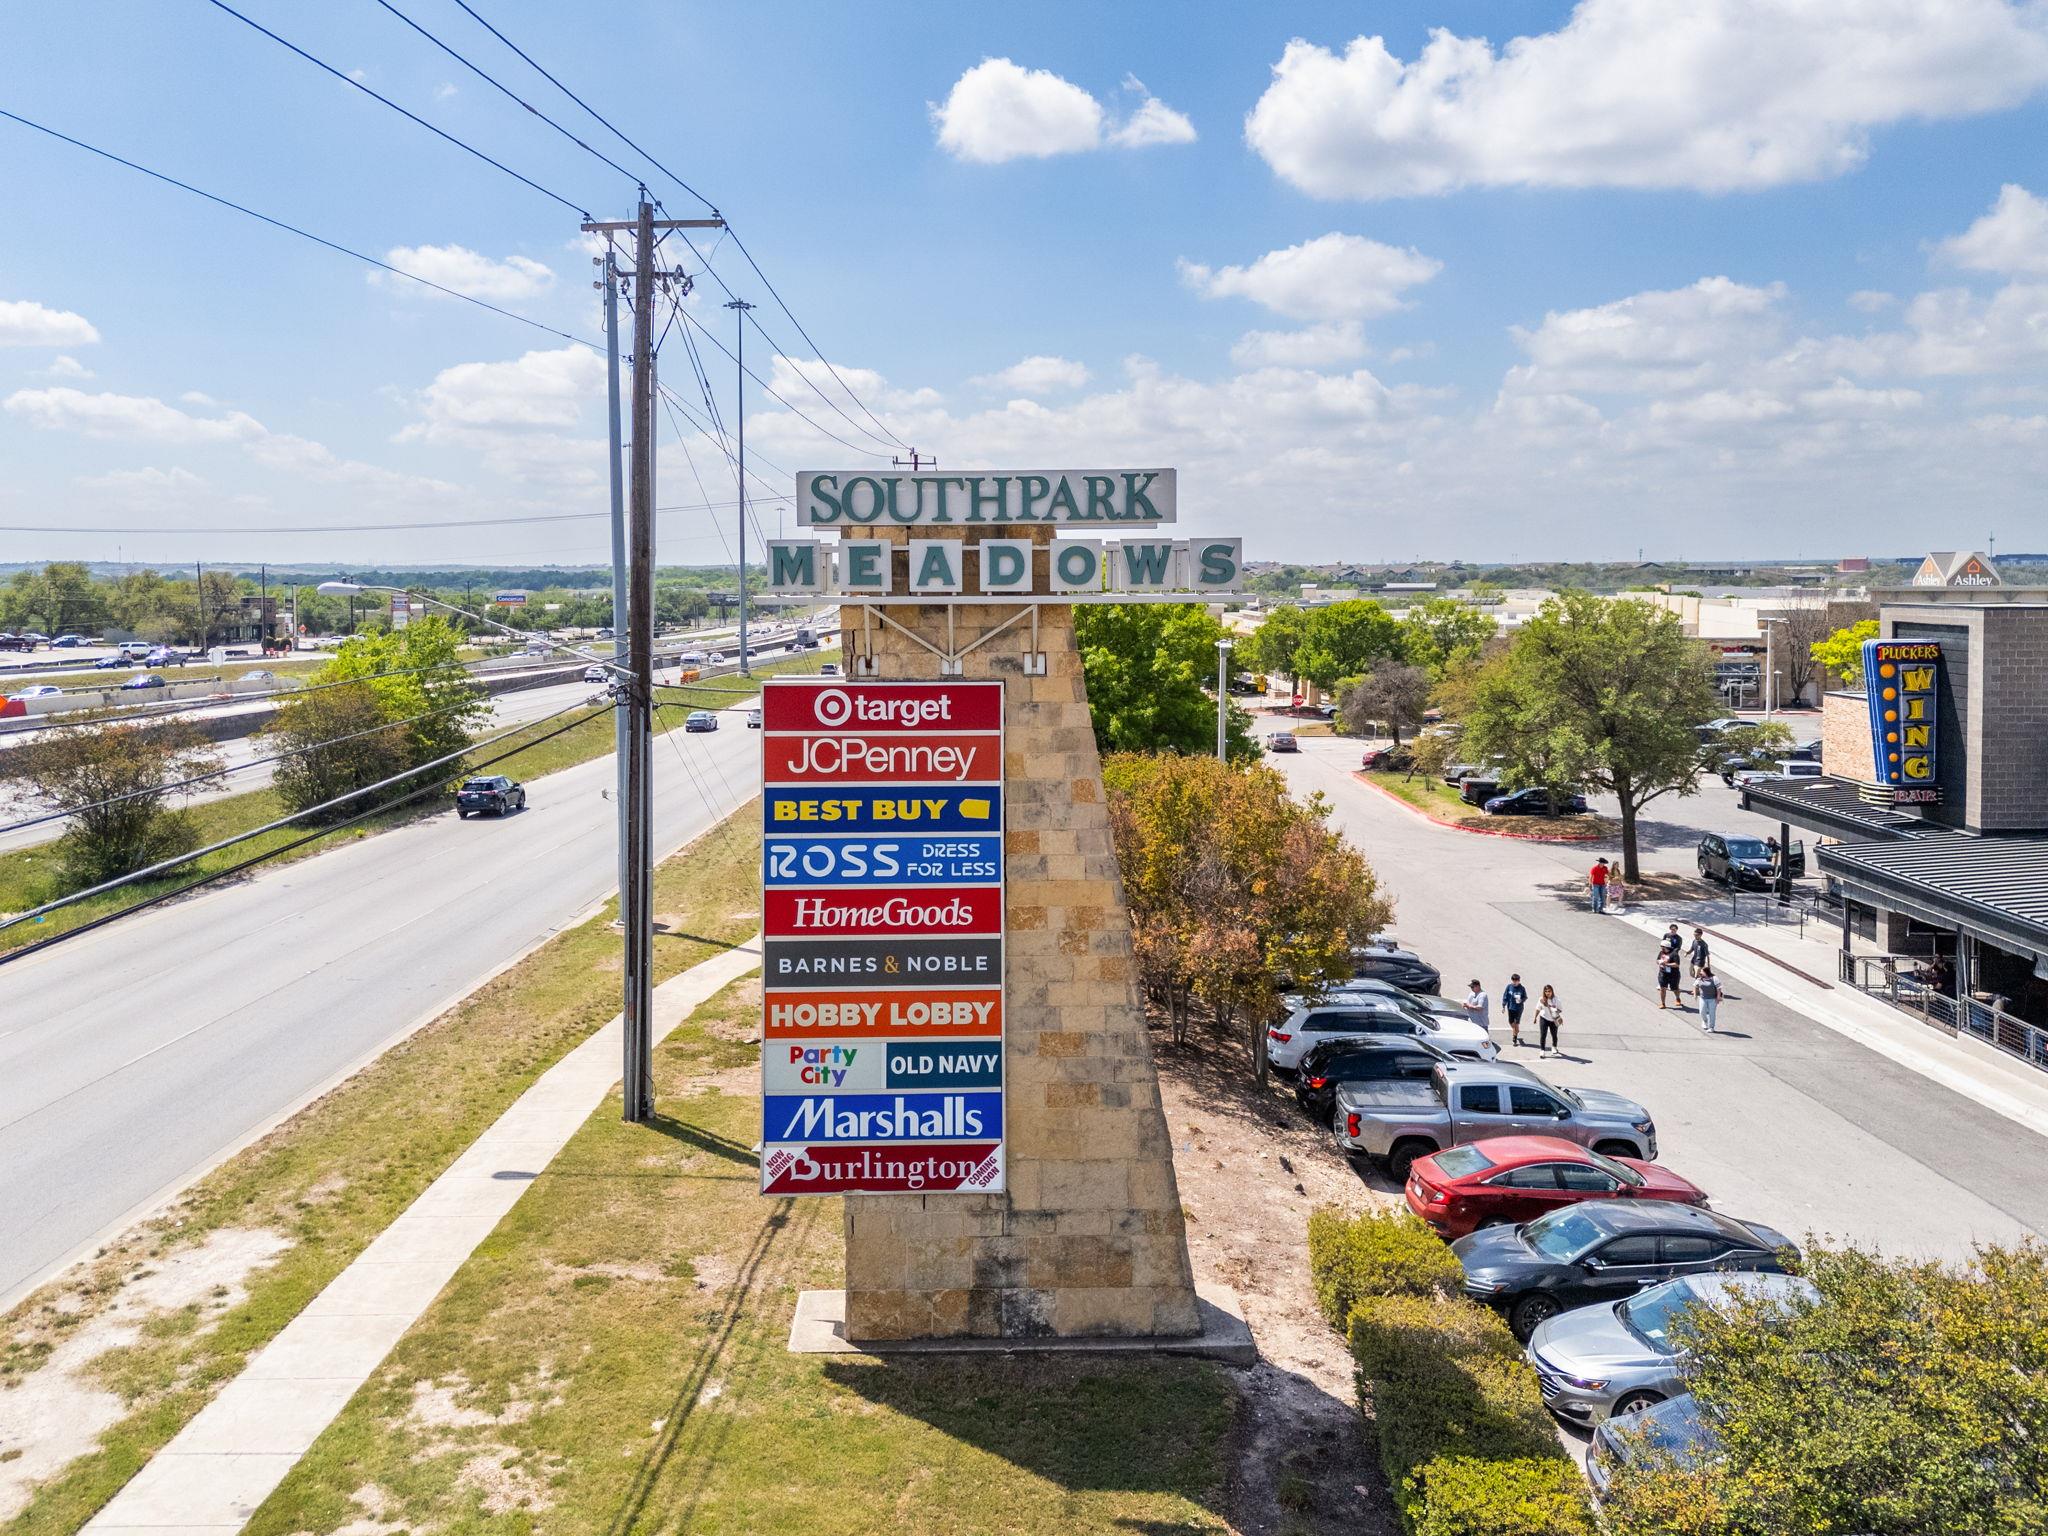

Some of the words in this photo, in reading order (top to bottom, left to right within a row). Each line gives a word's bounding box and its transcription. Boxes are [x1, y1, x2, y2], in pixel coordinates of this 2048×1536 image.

[810, 472, 1163, 523] SOUTHPARK
[772, 544, 1236, 587] MEADOWS
[1917, 573, 1941, 586] Ashley
[1954, 573, 1992, 587] Ashley
[1882, 646, 1938, 660] PLUCKERS
[856, 694, 952, 727] target
[1903, 667, 1933, 778] WING
[787, 737, 977, 781] JCPenney
[1893, 789, 1937, 802] BAR
[774, 800, 862, 821] BEST
[873, 799, 947, 821] BUY
[770, 845, 899, 878] ROSS
[922, 844, 980, 858] DRESS
[907, 863, 943, 877] FOR
[951, 863, 996, 877] LESS
[793, 898, 973, 928] HomeGoods
[779, 957, 877, 974] BARNES
[884, 956, 900, 974] &
[908, 956, 988, 972] NOBLE
[771, 1003, 882, 1028] HOBBY
[891, 1002, 995, 1026] LOBBY
[790, 1045, 858, 1067] Party
[891, 1057, 932, 1075] OLD
[939, 1055, 999, 1075] NAVY
[800, 1066, 848, 1088] City
[783, 1097, 983, 1139] Marshalls
[766, 1149, 785, 1169] NOW
[768, 1152, 795, 1179] HIRING
[790, 1151, 976, 1189] Burlington
[968, 1155, 998, 1185] COMING
[978, 1166, 1000, 1188] SOON
